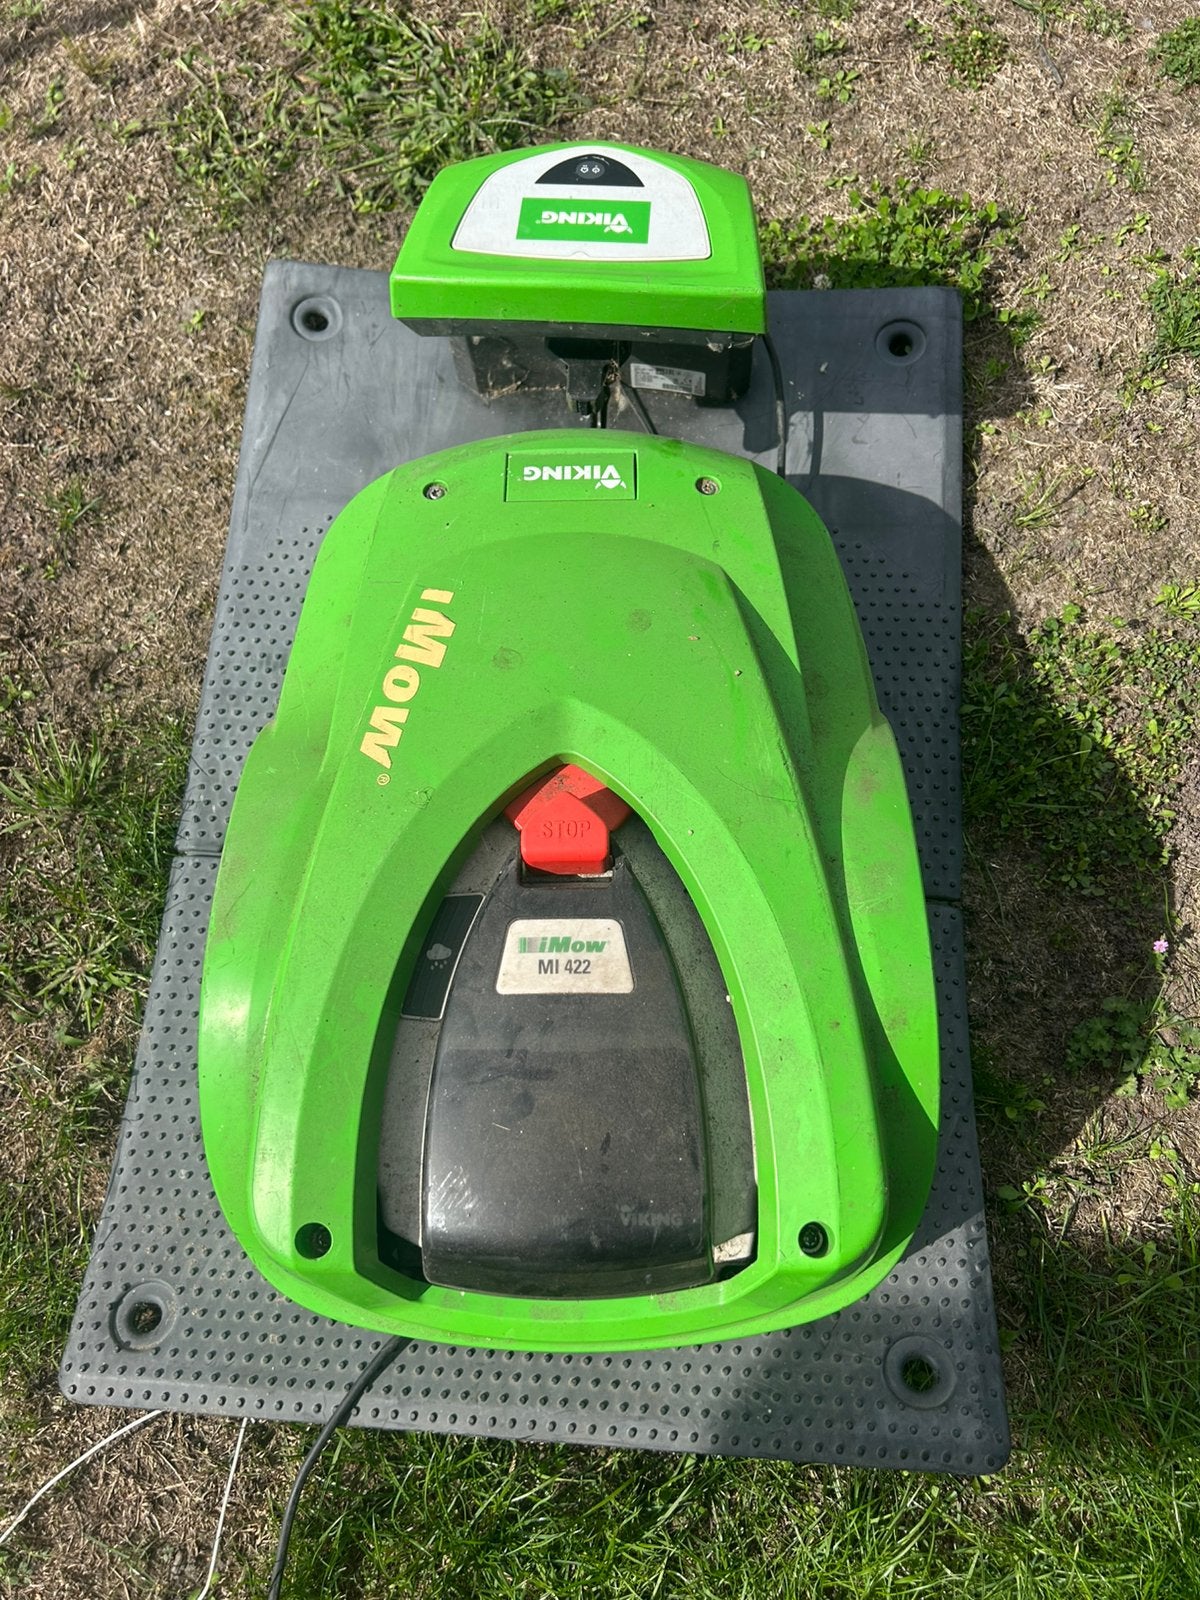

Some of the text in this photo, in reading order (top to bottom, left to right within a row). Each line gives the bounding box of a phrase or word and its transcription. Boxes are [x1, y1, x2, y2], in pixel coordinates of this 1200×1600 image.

[523, 465, 621, 481] VIKING
[541, 820, 591, 839] STOP
[538, 937, 607, 954] iMow
[538, 959, 591, 975] MI 422
[619, 1211, 683, 1227] VIKING
